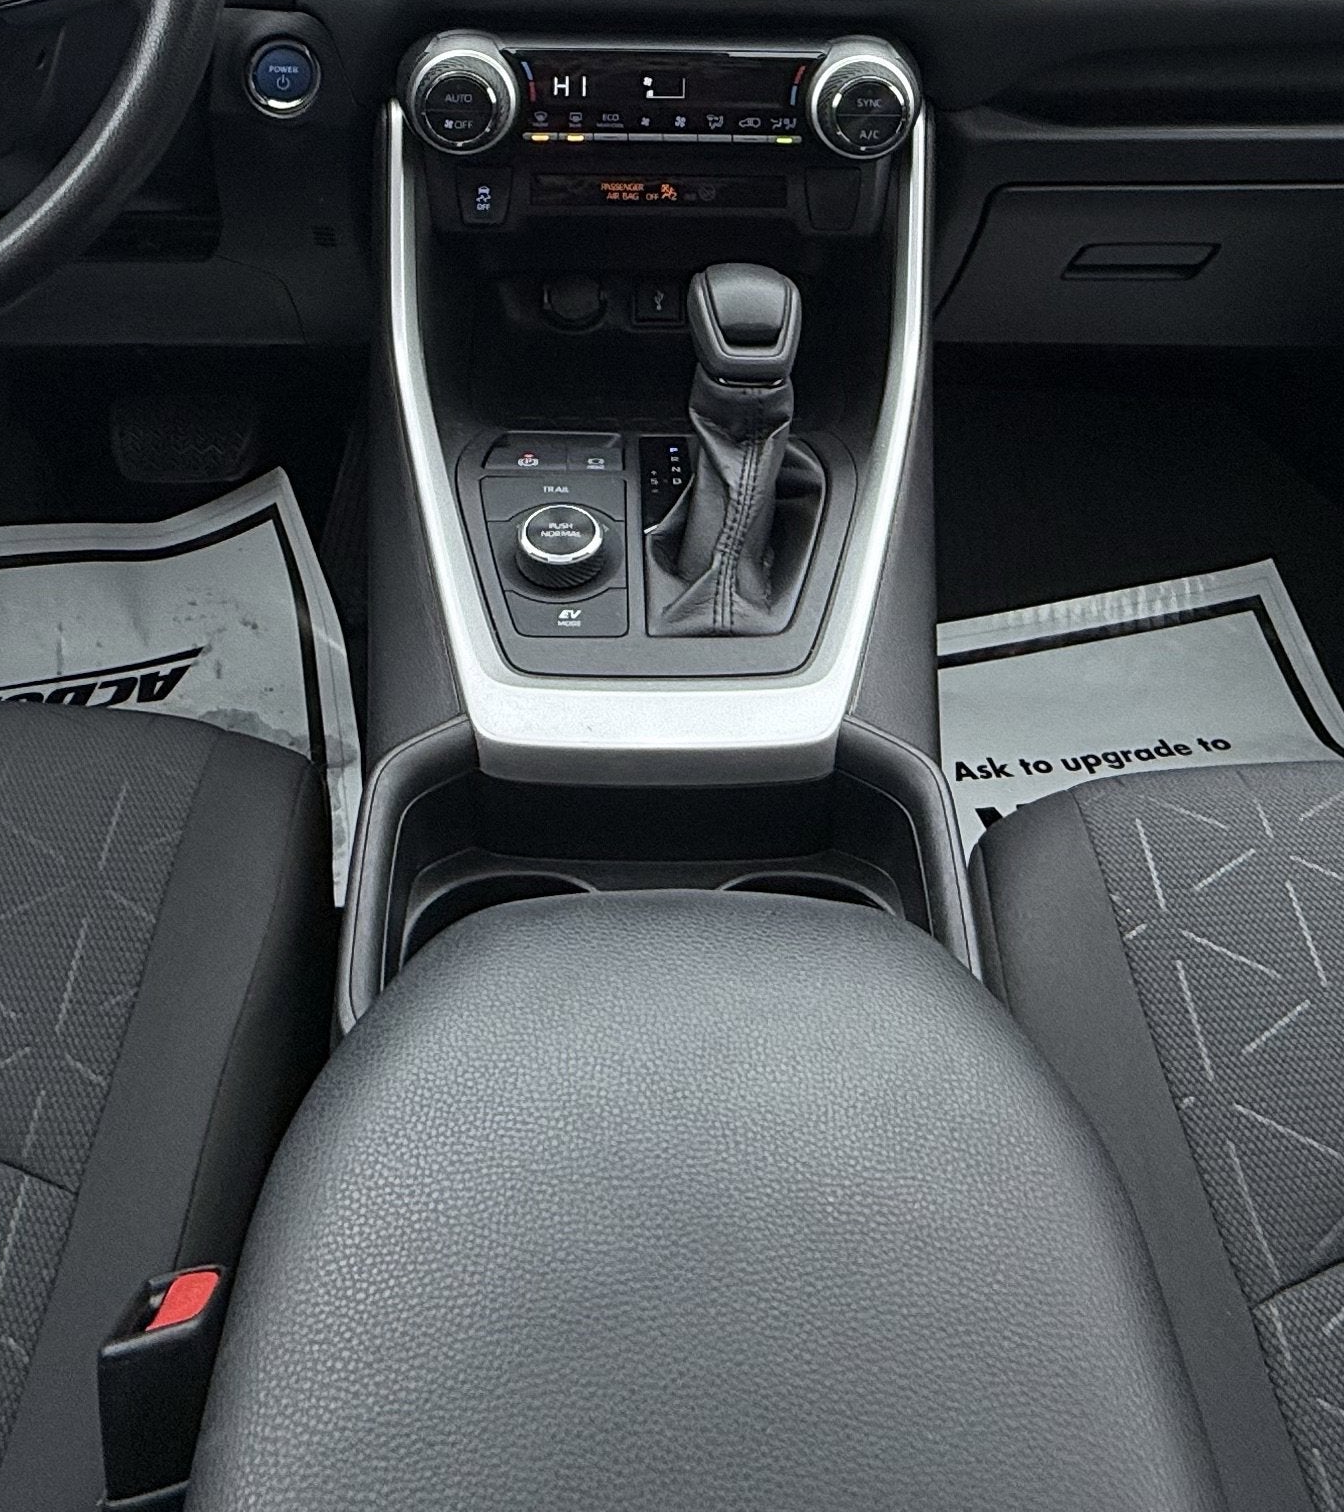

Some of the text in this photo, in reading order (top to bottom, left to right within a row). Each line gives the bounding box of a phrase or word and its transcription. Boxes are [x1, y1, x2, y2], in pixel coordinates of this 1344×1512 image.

[268, 65, 299, 73] POWER
[553, 74, 587, 97] HI
[444, 93, 473, 103] AUTO
[856, 98, 882, 108] SYNC
[602, 113, 620, 122] ECO
[454, 119, 473, 129] OFF
[859, 129, 879, 140] A/C
[600, 183, 645, 192] PASSENGER
[606, 192, 659, 201] AIR BAG OFF
[476, 203, 490, 211] OFF
[672, 477, 683, 485] D
[542, 485, 569, 493] TRAIL
[548, 522, 574, 530] PUSH
[540, 530, 582, 538] NORMAL
[558, 609, 582, 619] EV
[955, 735, 1232, 782] Ask to upgrade to
